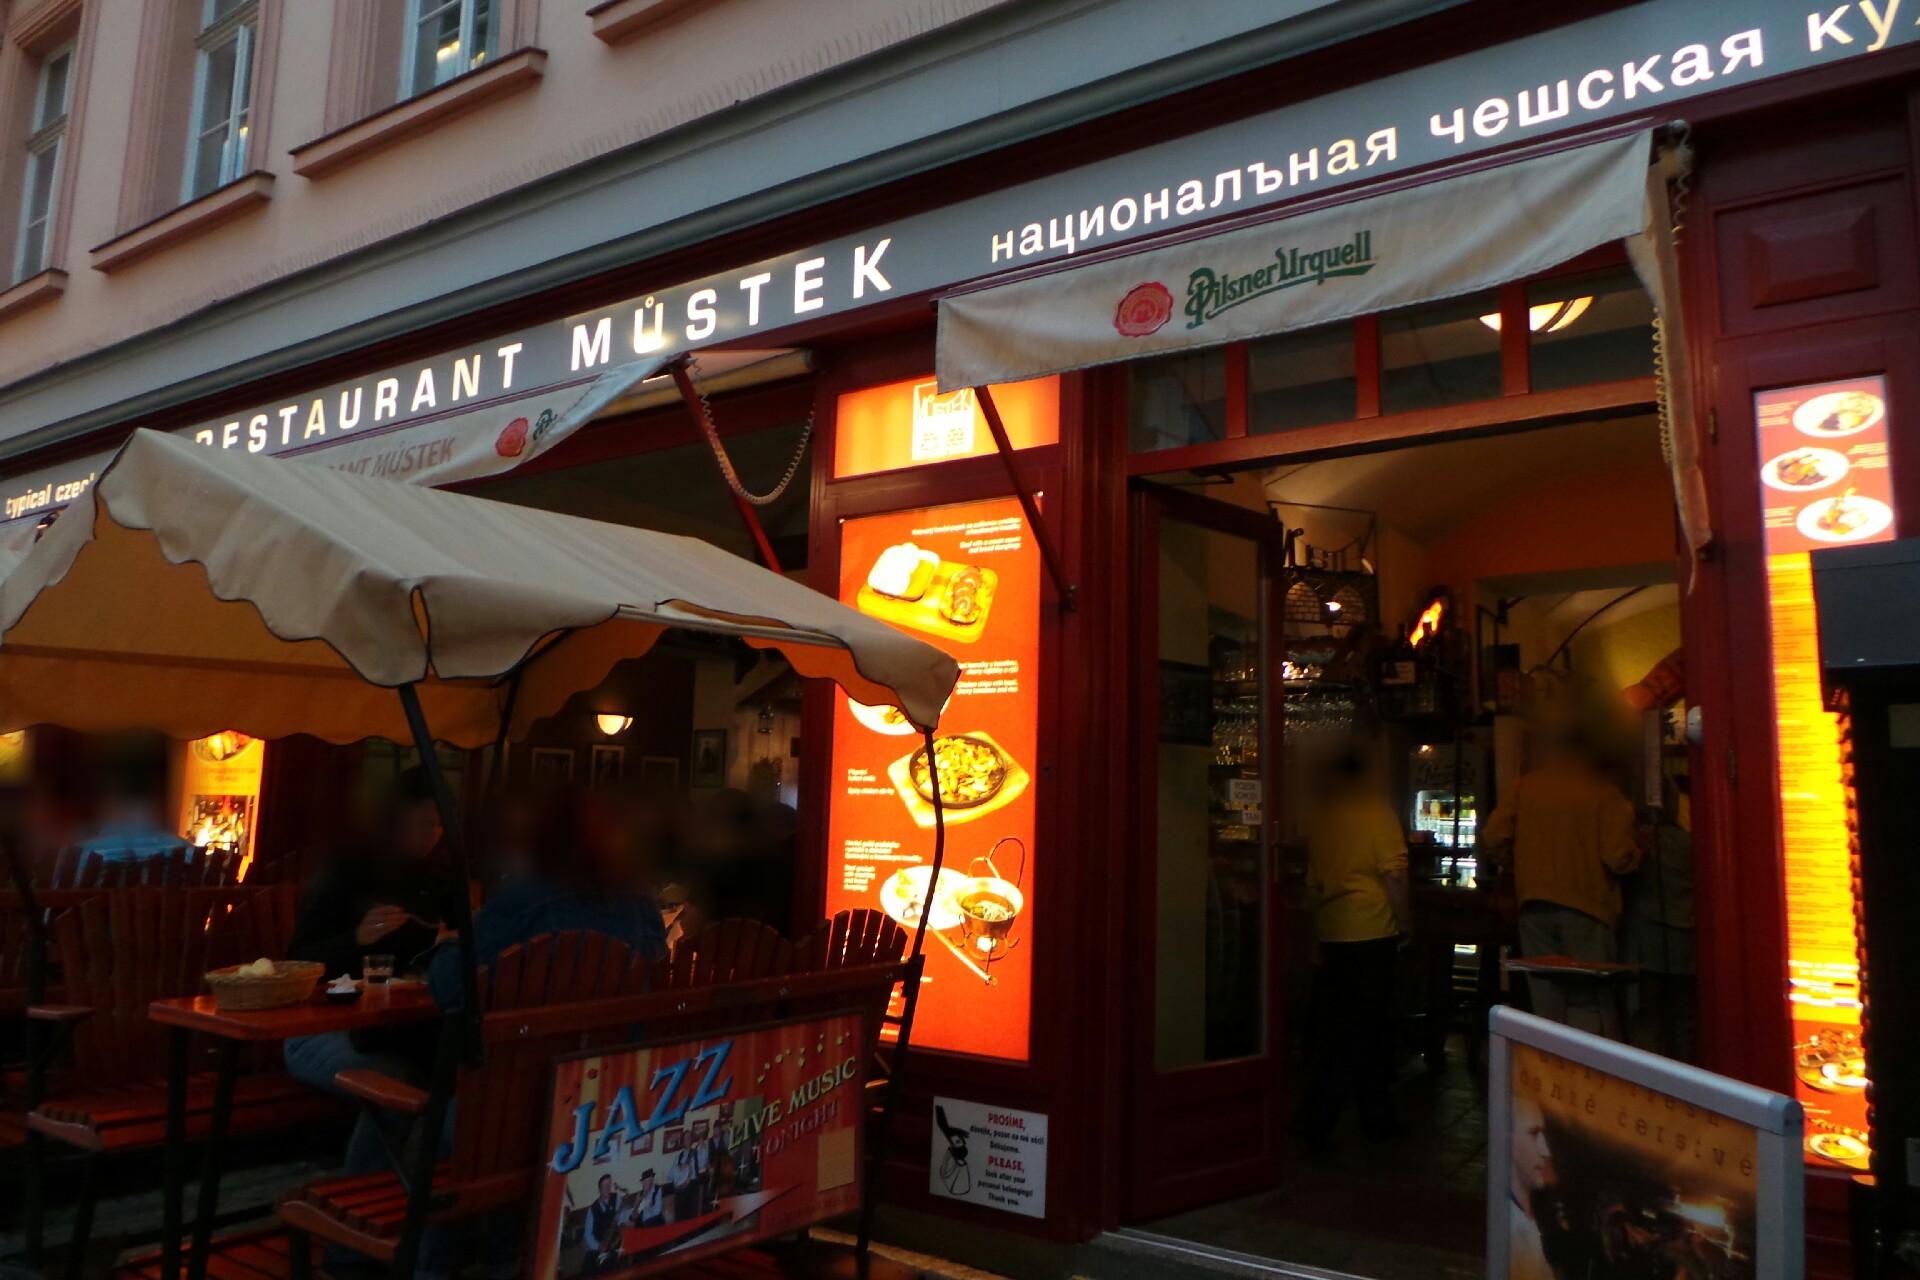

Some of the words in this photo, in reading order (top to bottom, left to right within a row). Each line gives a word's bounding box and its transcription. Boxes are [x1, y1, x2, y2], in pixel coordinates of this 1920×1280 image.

[1429, 27, 1763, 144] чешская
[1807, 0, 1920, 53] ку
[1185, 264, 1278, 329] Pilsner
[1275, 230, 1371, 286] Urquell
[5, 483, 52, 519] typical
[550, 1039, 735, 1174] JAZZ
[727, 1101, 784, 1151] LIVE
[787, 1056, 857, 1115] MUSIC
[987, 1155, 1024, 1173] PLEASE,
